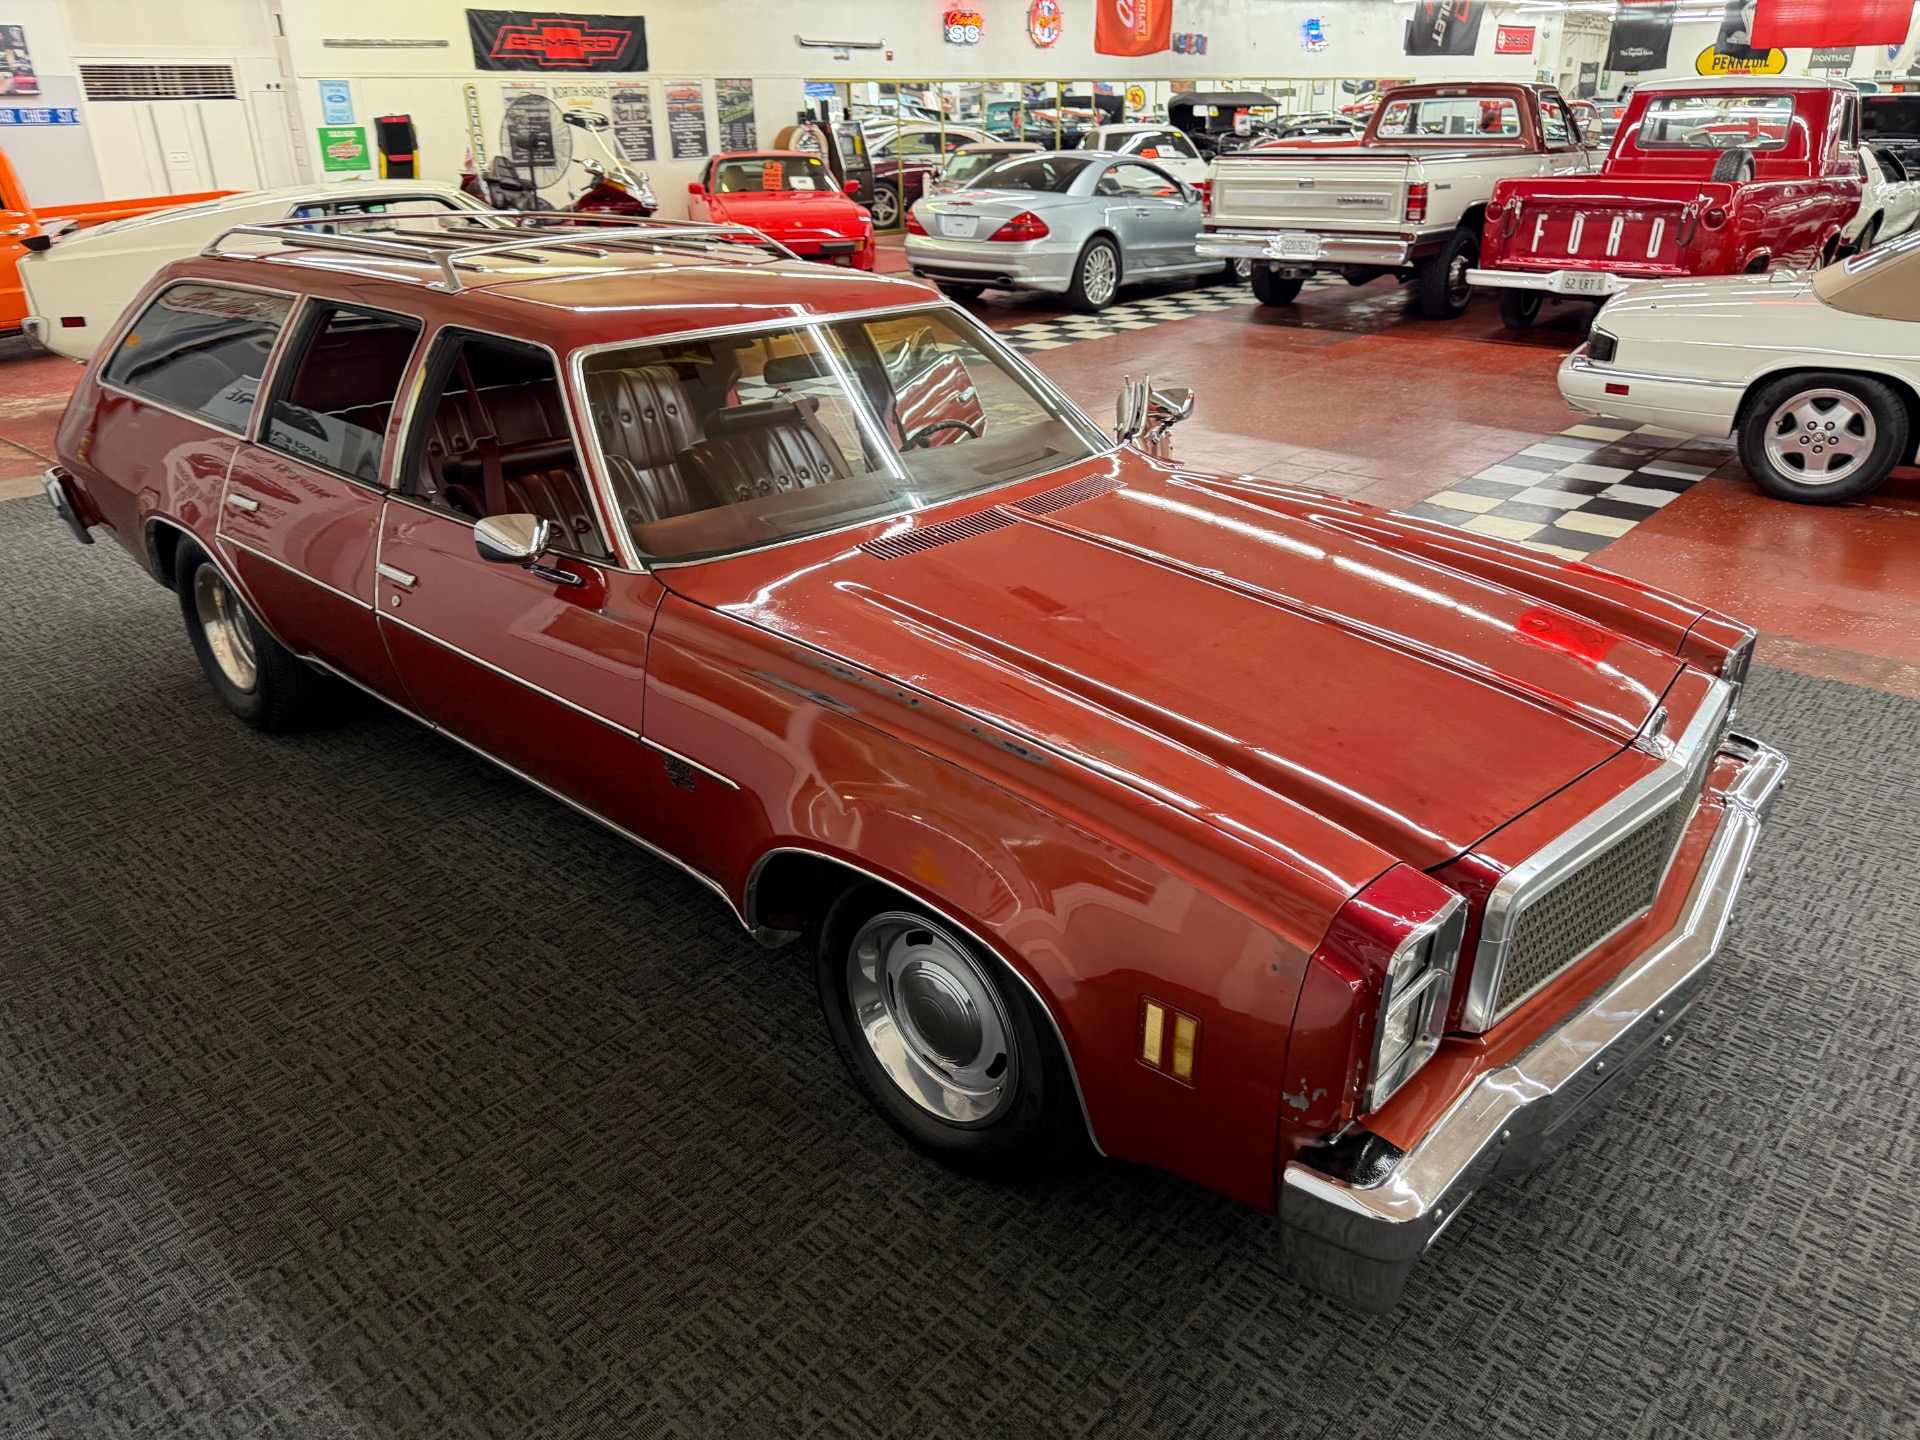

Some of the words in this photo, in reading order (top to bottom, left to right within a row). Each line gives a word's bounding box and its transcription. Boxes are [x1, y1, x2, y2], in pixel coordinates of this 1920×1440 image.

[1138, 0, 1148, 35] OLET
[948, 25, 980, 43] SS
[512, 37, 611, 48] CAMARO
[1811, 54, 1851, 63] PONTIAC
[552, 86, 579, 99] NORTH
[581, 86, 609, 99] SHORE
[1531, 213, 1665, 259] FORD
[1564, 277, 1576, 290] 62
[1578, 278, 1595, 291] LRT
